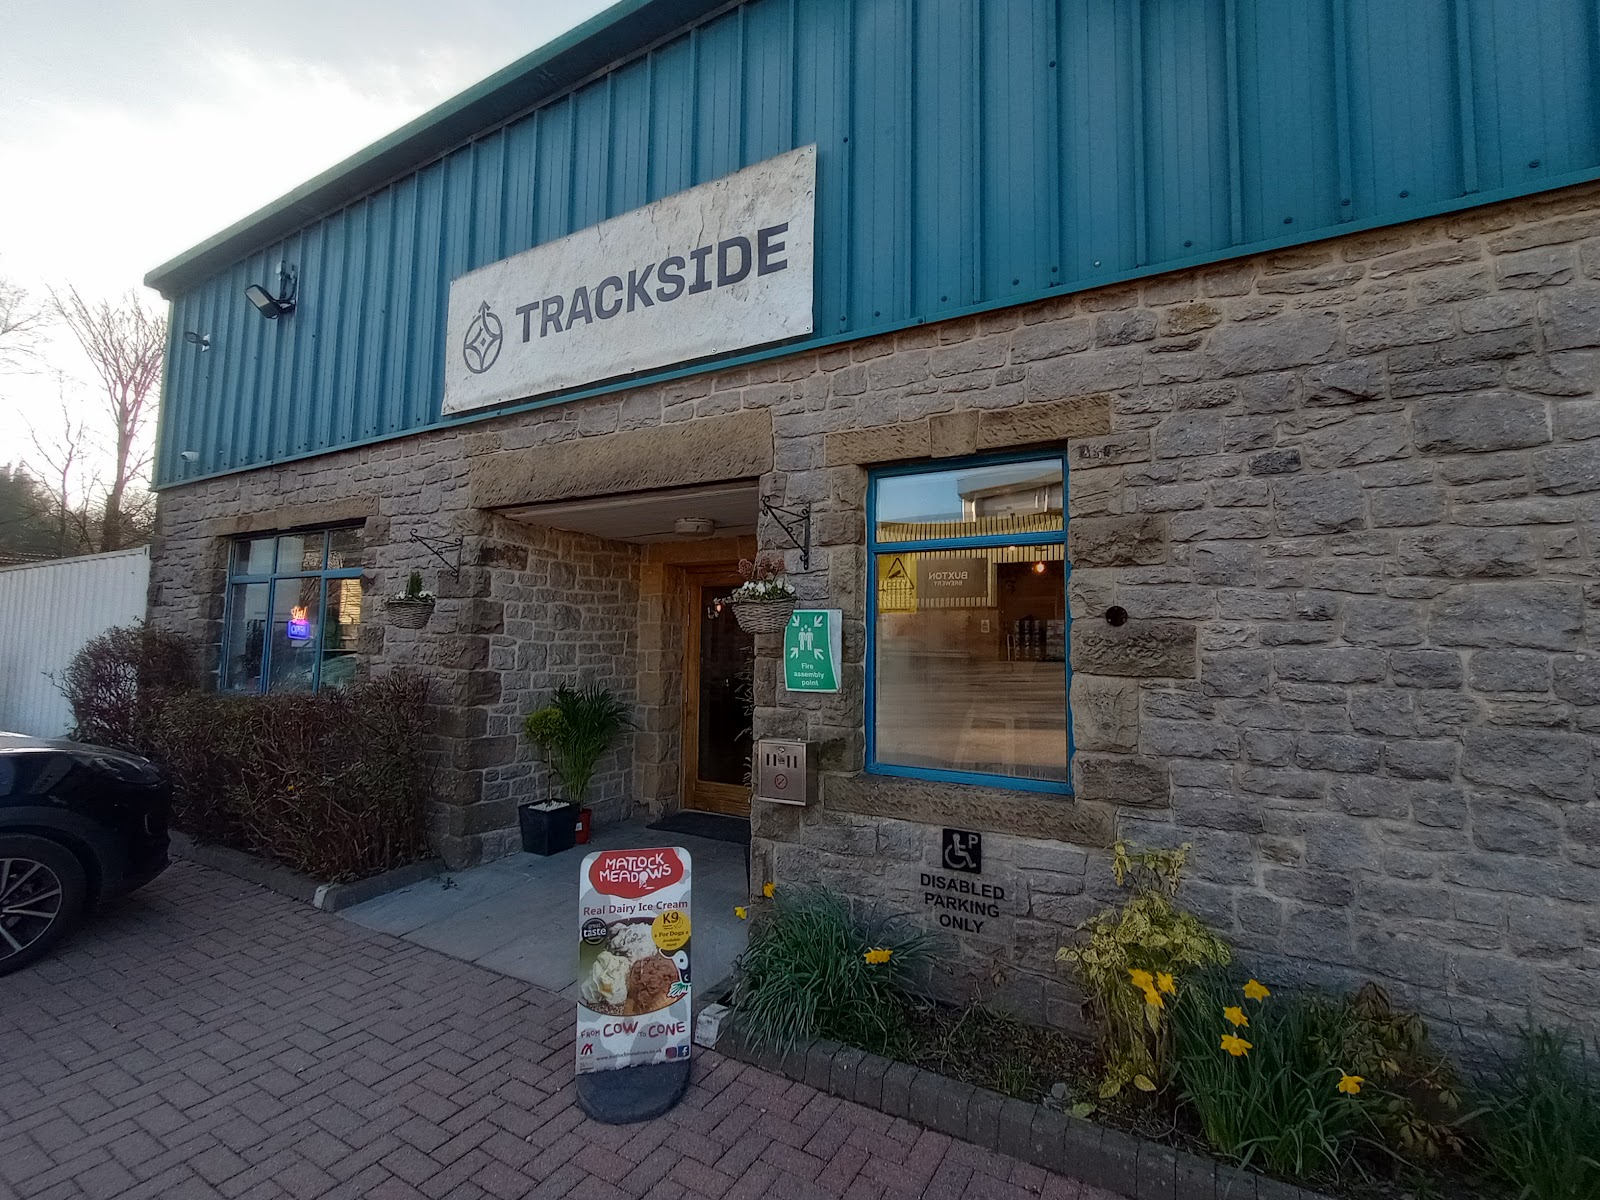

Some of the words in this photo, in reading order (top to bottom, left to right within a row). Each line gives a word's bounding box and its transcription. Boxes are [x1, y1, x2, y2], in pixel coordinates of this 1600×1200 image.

[515, 222, 789, 343] TRACKSIDE
[801, 662, 814, 670] Fire
[794, 671, 825, 680] assembly
[801, 679, 819, 687] point
[968, 834, 979, 849] P
[605, 852, 665, 871] MATLOCK
[599, 864, 672, 884] MEADOWS
[920, 873, 1005, 899] DISABLED
[583, 905, 606, 916] Real
[608, 904, 636, 915] Dairy
[638, 902, 654, 912] Ice
[656, 901, 688, 910] Cream
[924, 892, 1000, 917] PARKING
[663, 912, 679, 924] K9
[940, 914, 984, 934] ONLY
[583, 928, 607, 938] taste
[581, 1029, 601, 1038] FROM
[603, 1021, 639, 1038] COW
[648, 1022, 686, 1038] CONE
